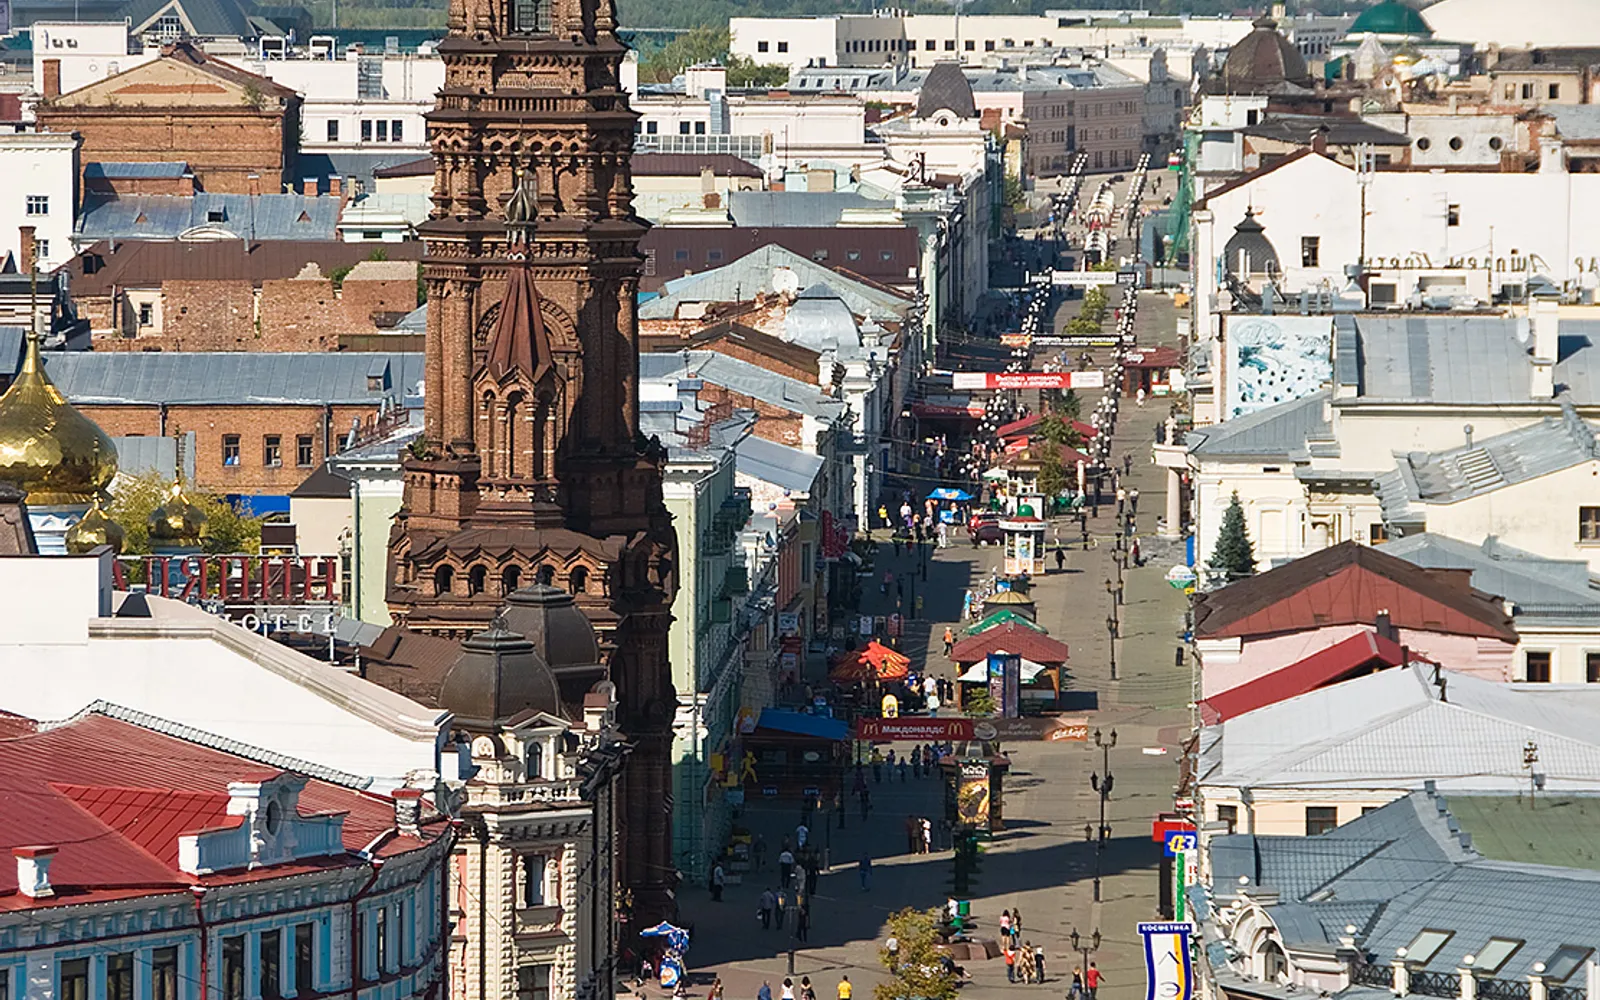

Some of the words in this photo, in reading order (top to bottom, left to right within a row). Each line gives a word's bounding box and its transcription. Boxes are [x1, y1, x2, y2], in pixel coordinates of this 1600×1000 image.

[223, 613, 339, 634] OTEL
[881, 725, 945, 735] Макдоналдс
[1142, 924, 1190, 932] КОСМЕТИКА
